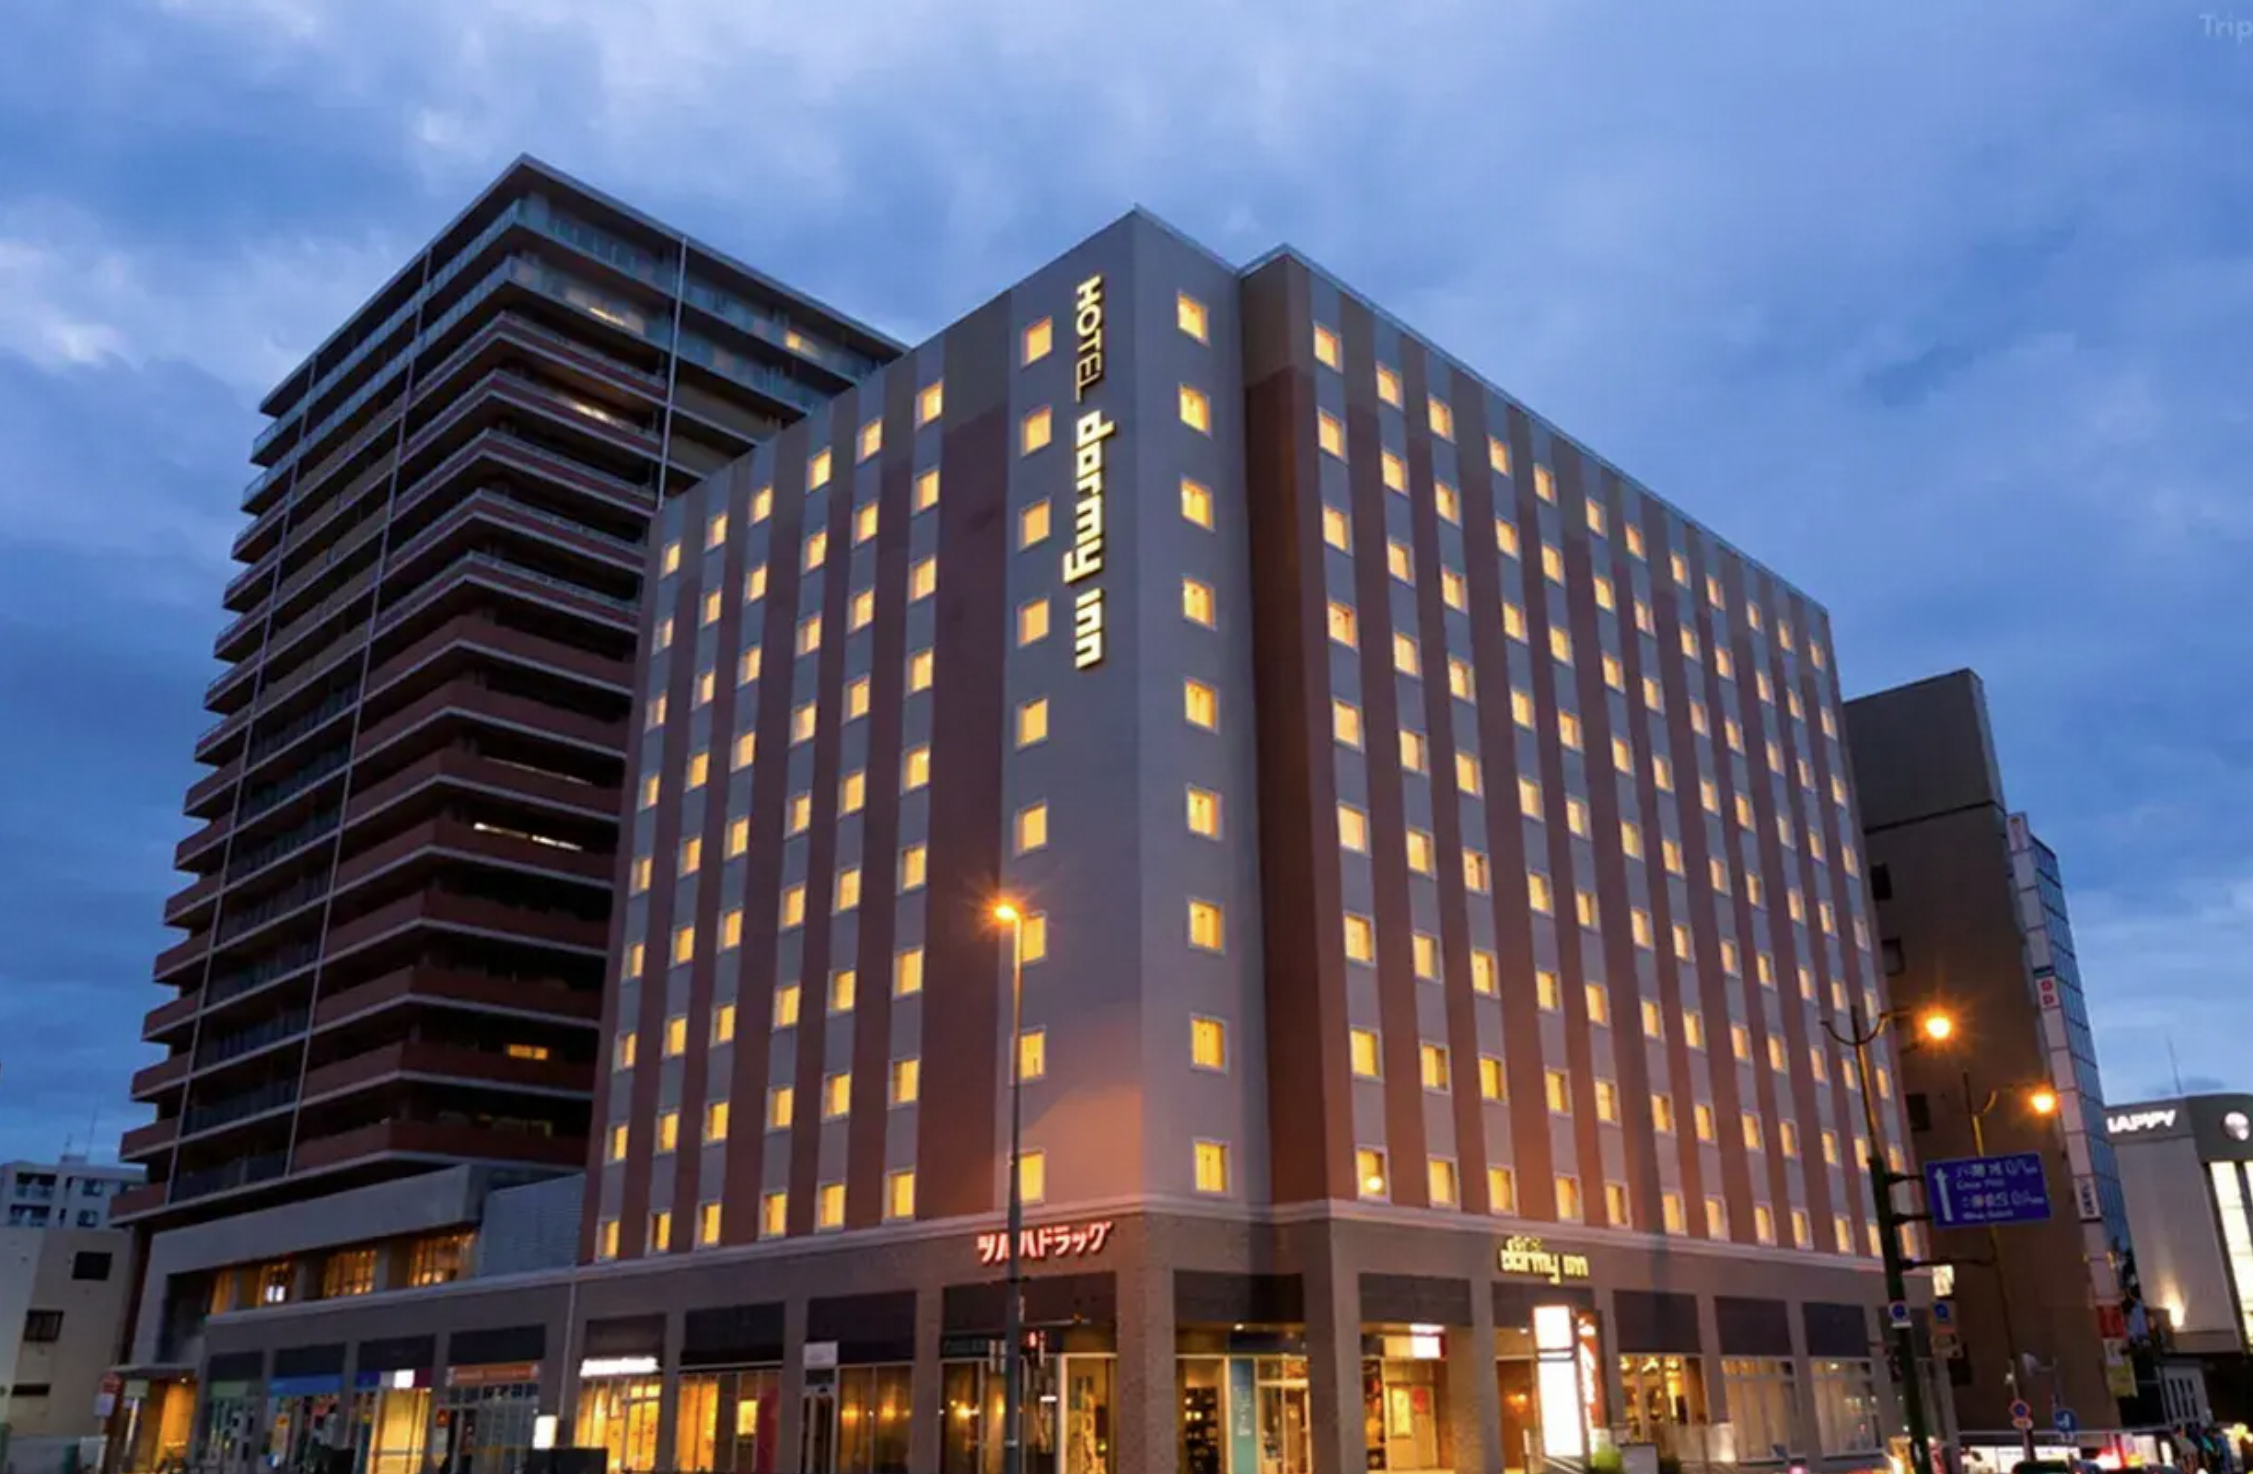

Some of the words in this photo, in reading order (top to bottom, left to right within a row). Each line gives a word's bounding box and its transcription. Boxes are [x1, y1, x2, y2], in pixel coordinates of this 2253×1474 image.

[1076, 275, 1102, 402] HOTEL
[1063, 410, 1116, 584] dormy
[1075, 588, 1103, 669] inn
[1500, 1249, 1561, 1284] dormy
[1562, 1255, 1589, 1277] inn
